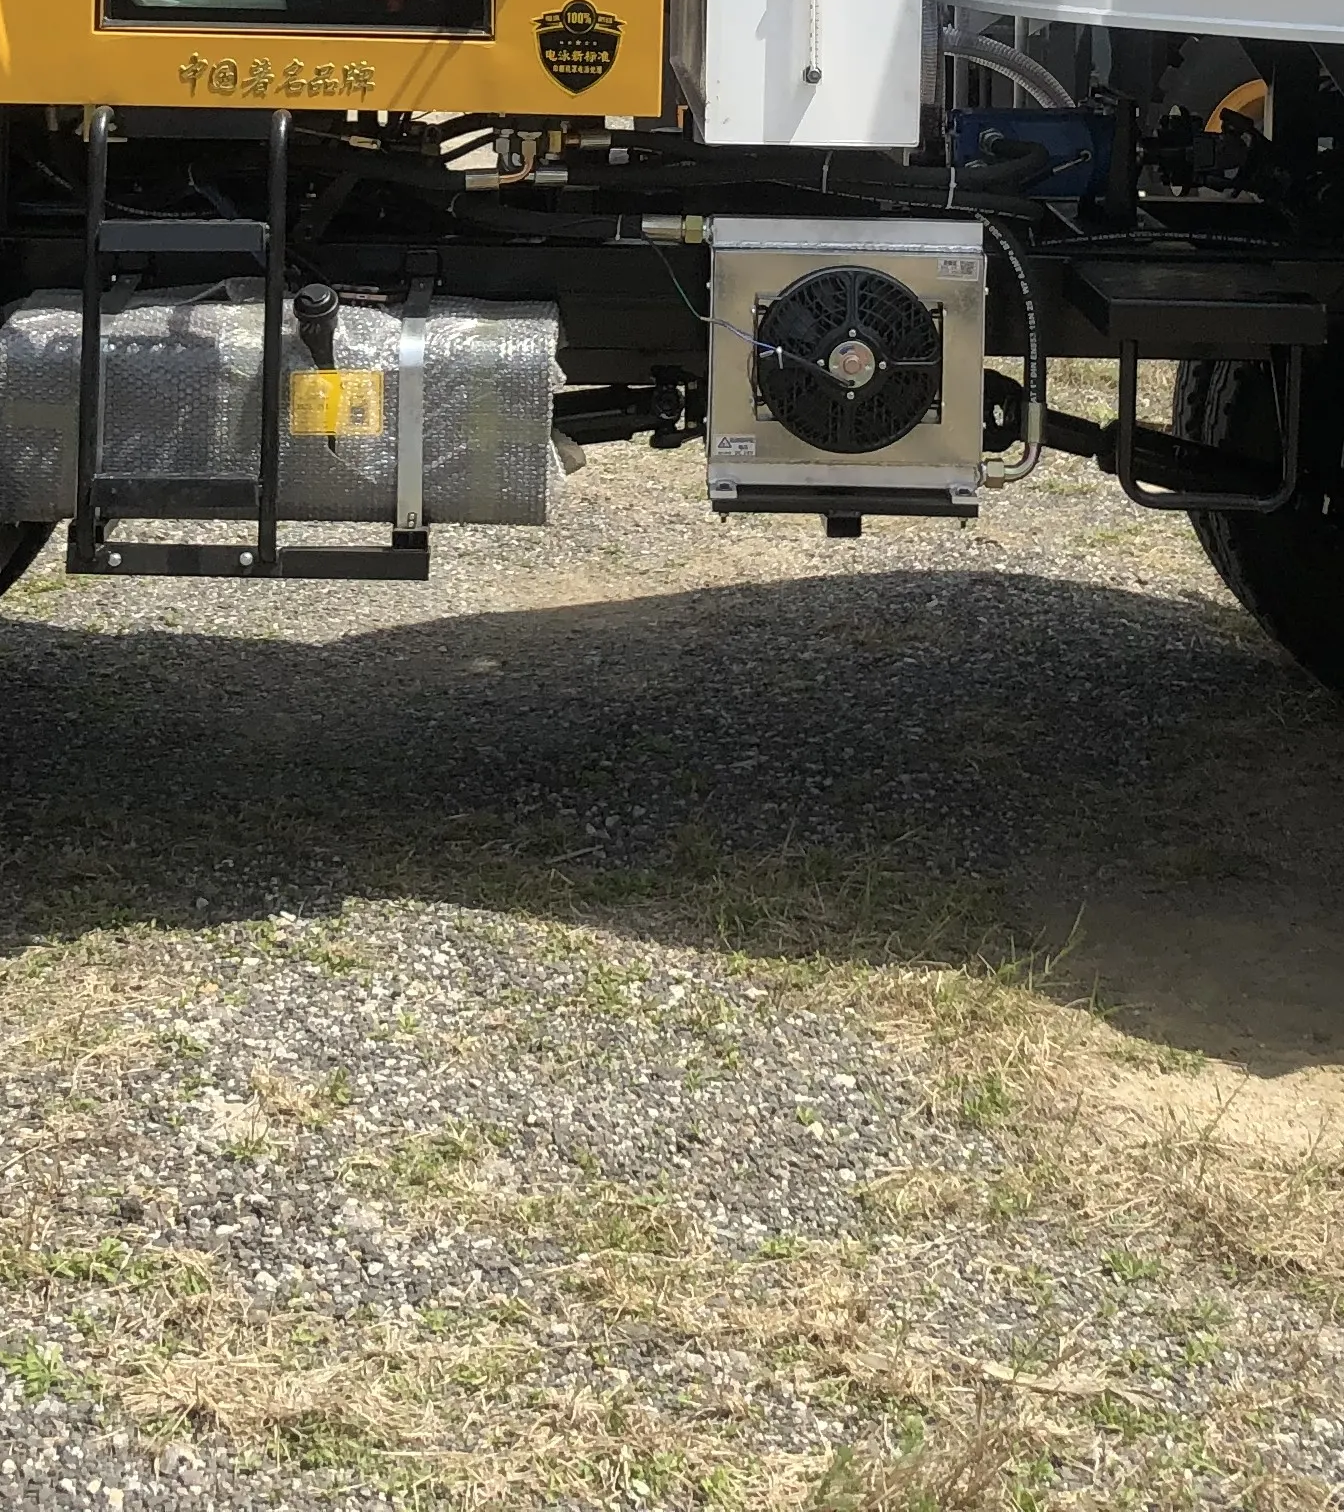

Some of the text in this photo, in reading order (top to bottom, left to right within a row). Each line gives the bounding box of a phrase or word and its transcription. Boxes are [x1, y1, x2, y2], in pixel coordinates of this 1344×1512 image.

[567, 12, 592, 25] 100%
[177, 52, 377, 102] 中国著名品牌
